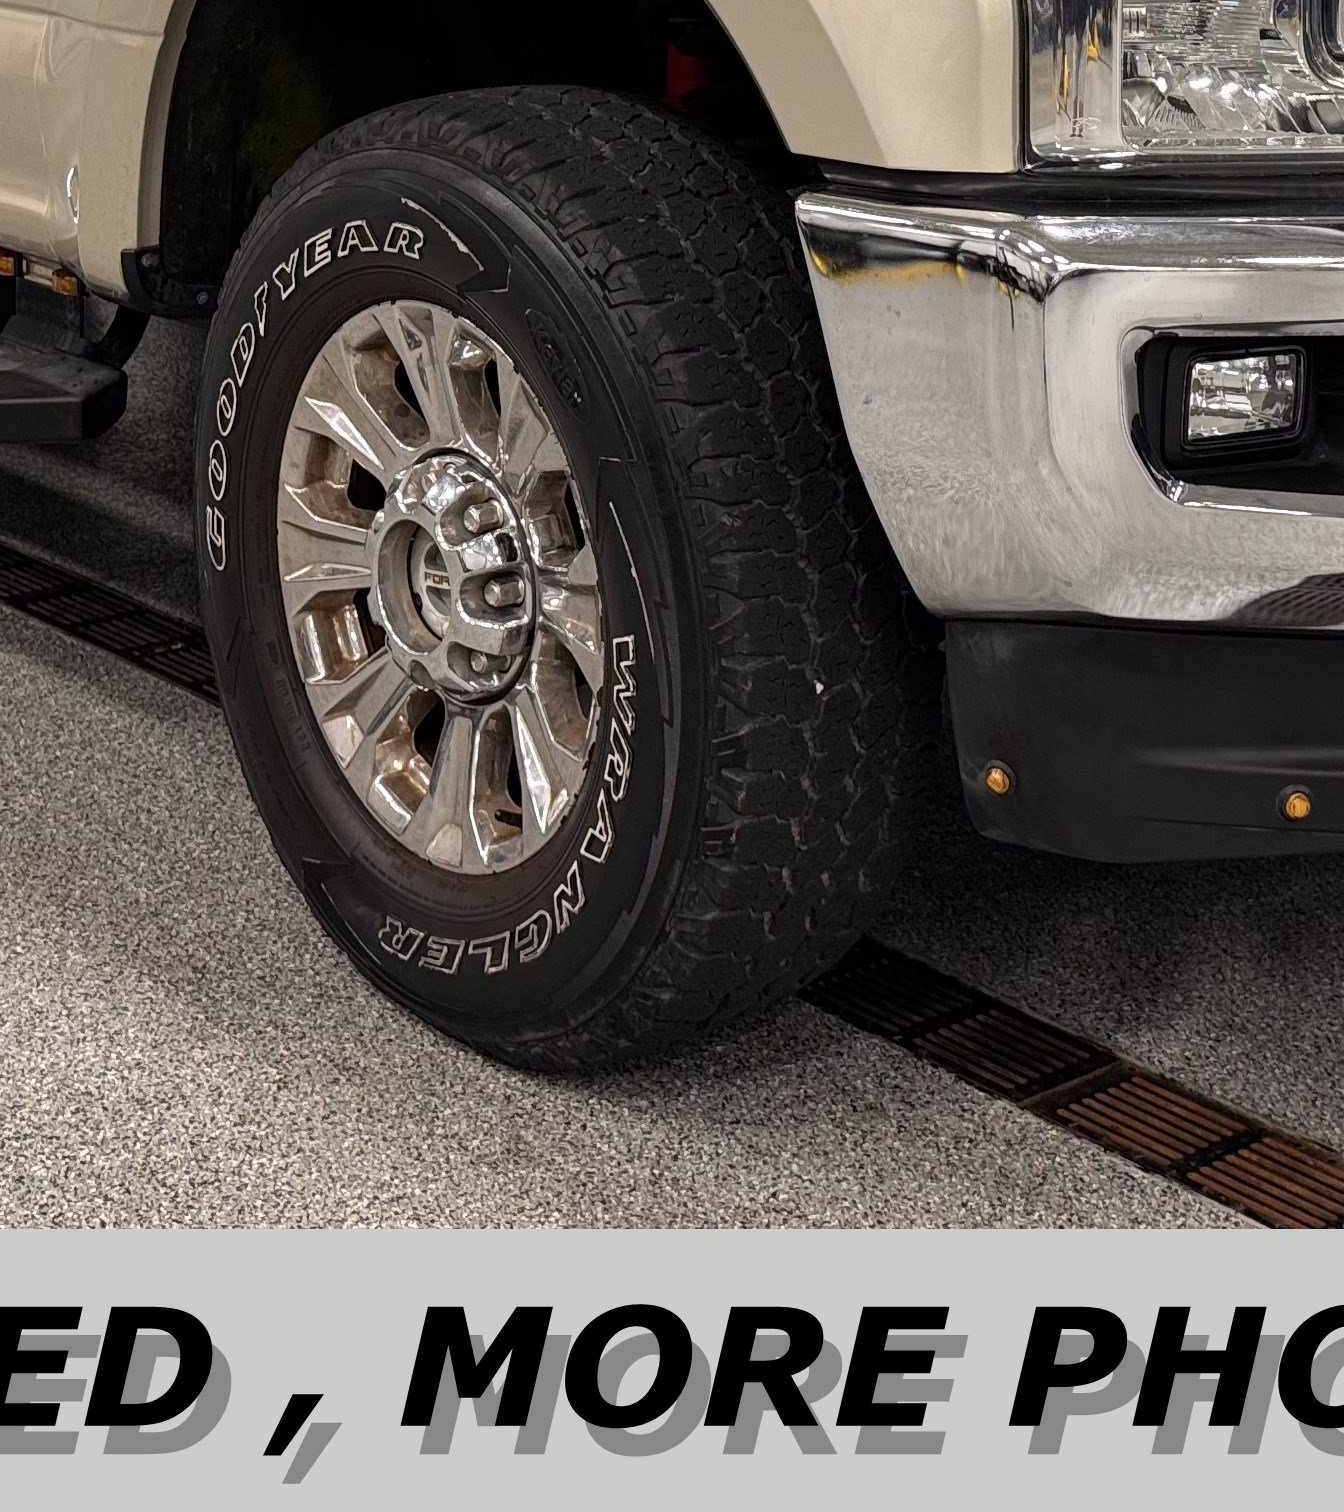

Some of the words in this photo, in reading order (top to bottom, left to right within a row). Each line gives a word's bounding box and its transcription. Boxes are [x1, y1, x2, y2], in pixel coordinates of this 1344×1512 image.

[207, 220, 424, 571] GOODYEAR
[424, 571, 451, 587] FOR
[378, 635, 637, 975] WRANGLER
